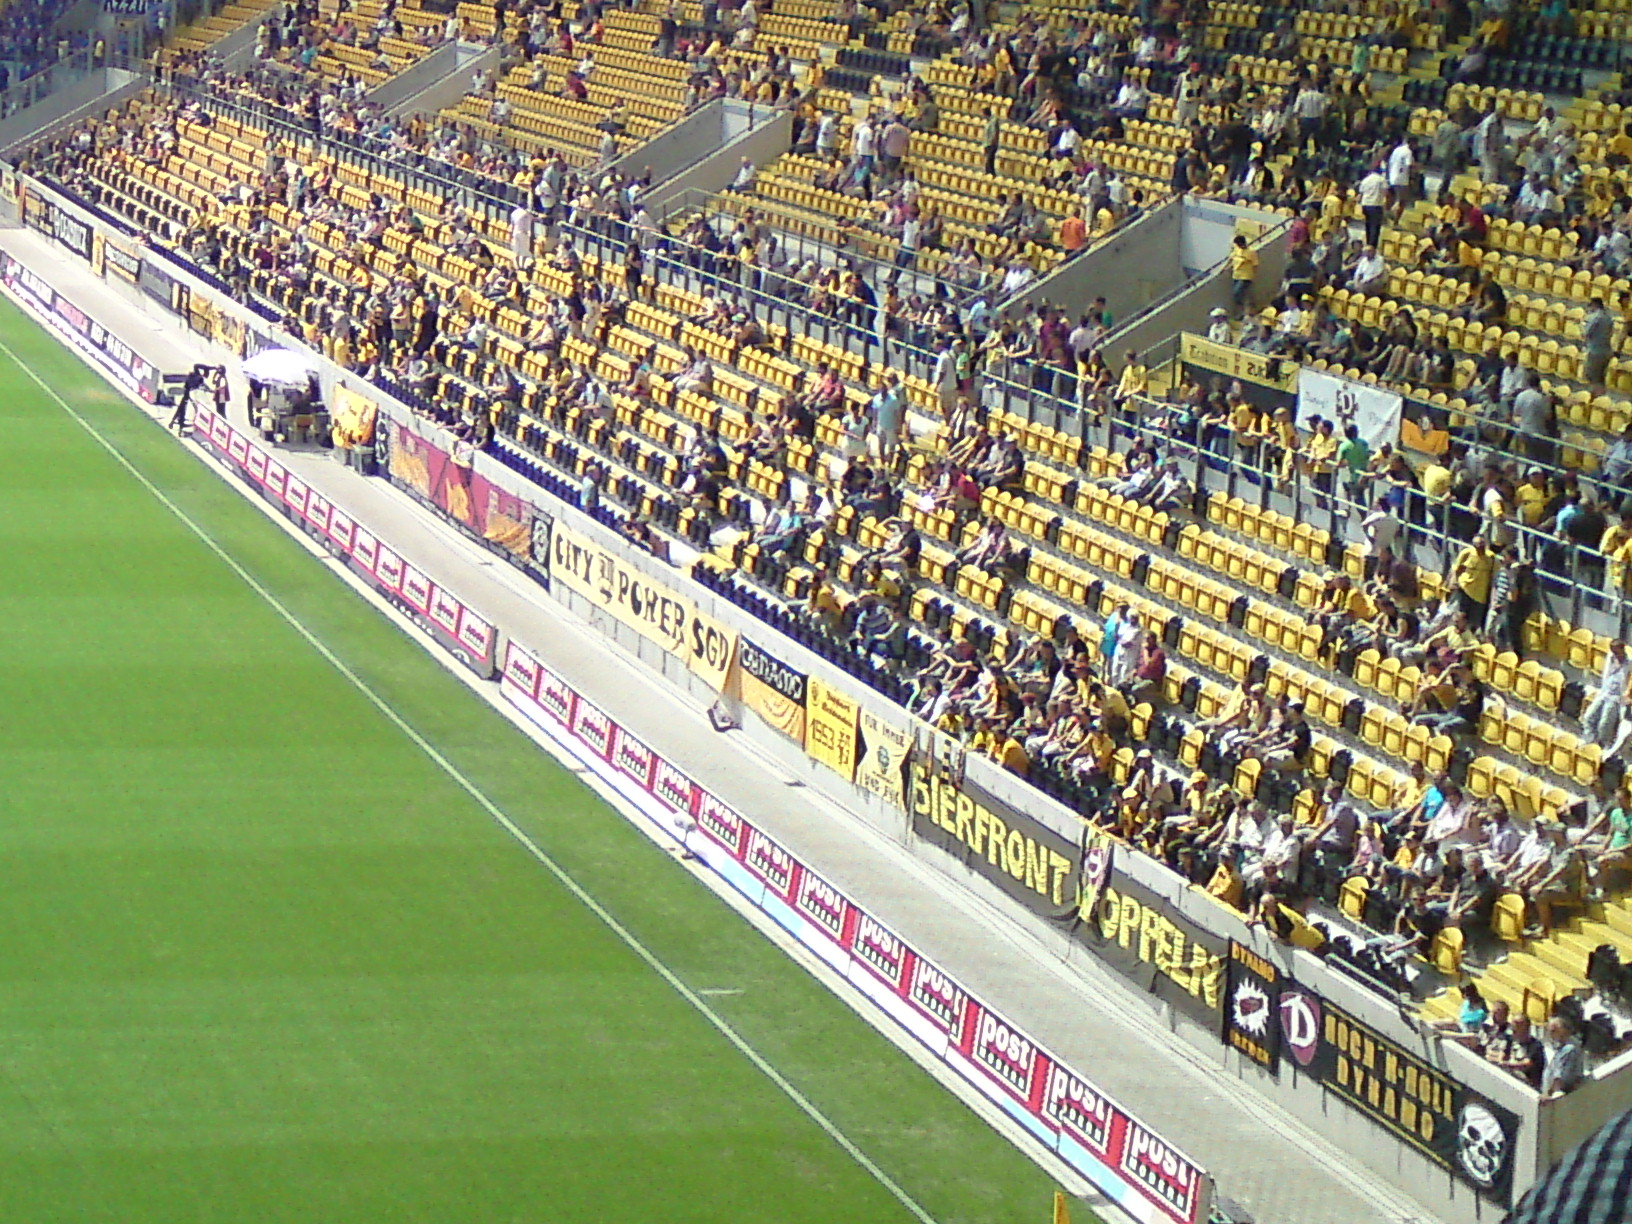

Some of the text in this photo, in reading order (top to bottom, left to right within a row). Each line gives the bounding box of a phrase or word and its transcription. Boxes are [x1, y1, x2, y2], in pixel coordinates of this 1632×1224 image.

[556, 533, 594, 585] CITY
[692, 617, 729, 672] SGD
[981, 1013, 1030, 1070] post
[1337, 1054, 1434, 1142] DYNAMO
